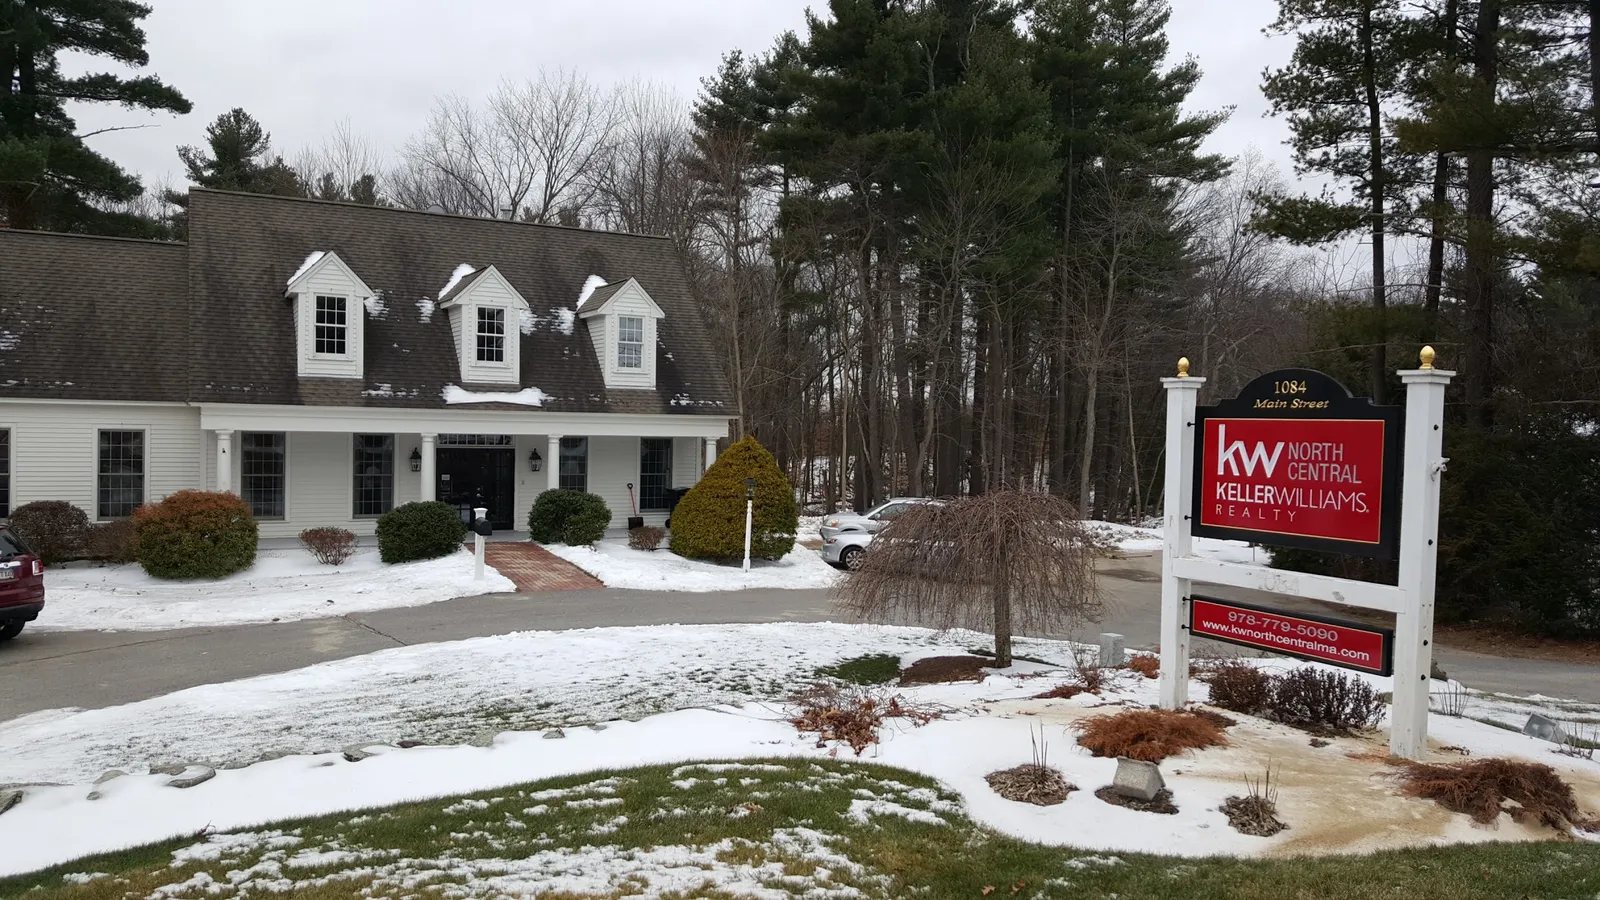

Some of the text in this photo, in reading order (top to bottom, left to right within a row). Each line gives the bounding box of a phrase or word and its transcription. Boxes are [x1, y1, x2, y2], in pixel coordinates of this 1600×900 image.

[1274, 380, 1307, 394] 1084
[1253, 398, 1330, 409] Main Street
[1217, 424, 1285, 478] kw
[1288, 442, 1343, 462] NORTH
[1288, 462, 1362, 484] CENTRAL
[1215, 504, 1297, 522] REALTY
[1227, 611, 1339, 642] 978-779-5090
[1202, 620, 1370, 661] www.kwnorthcentralma.com
